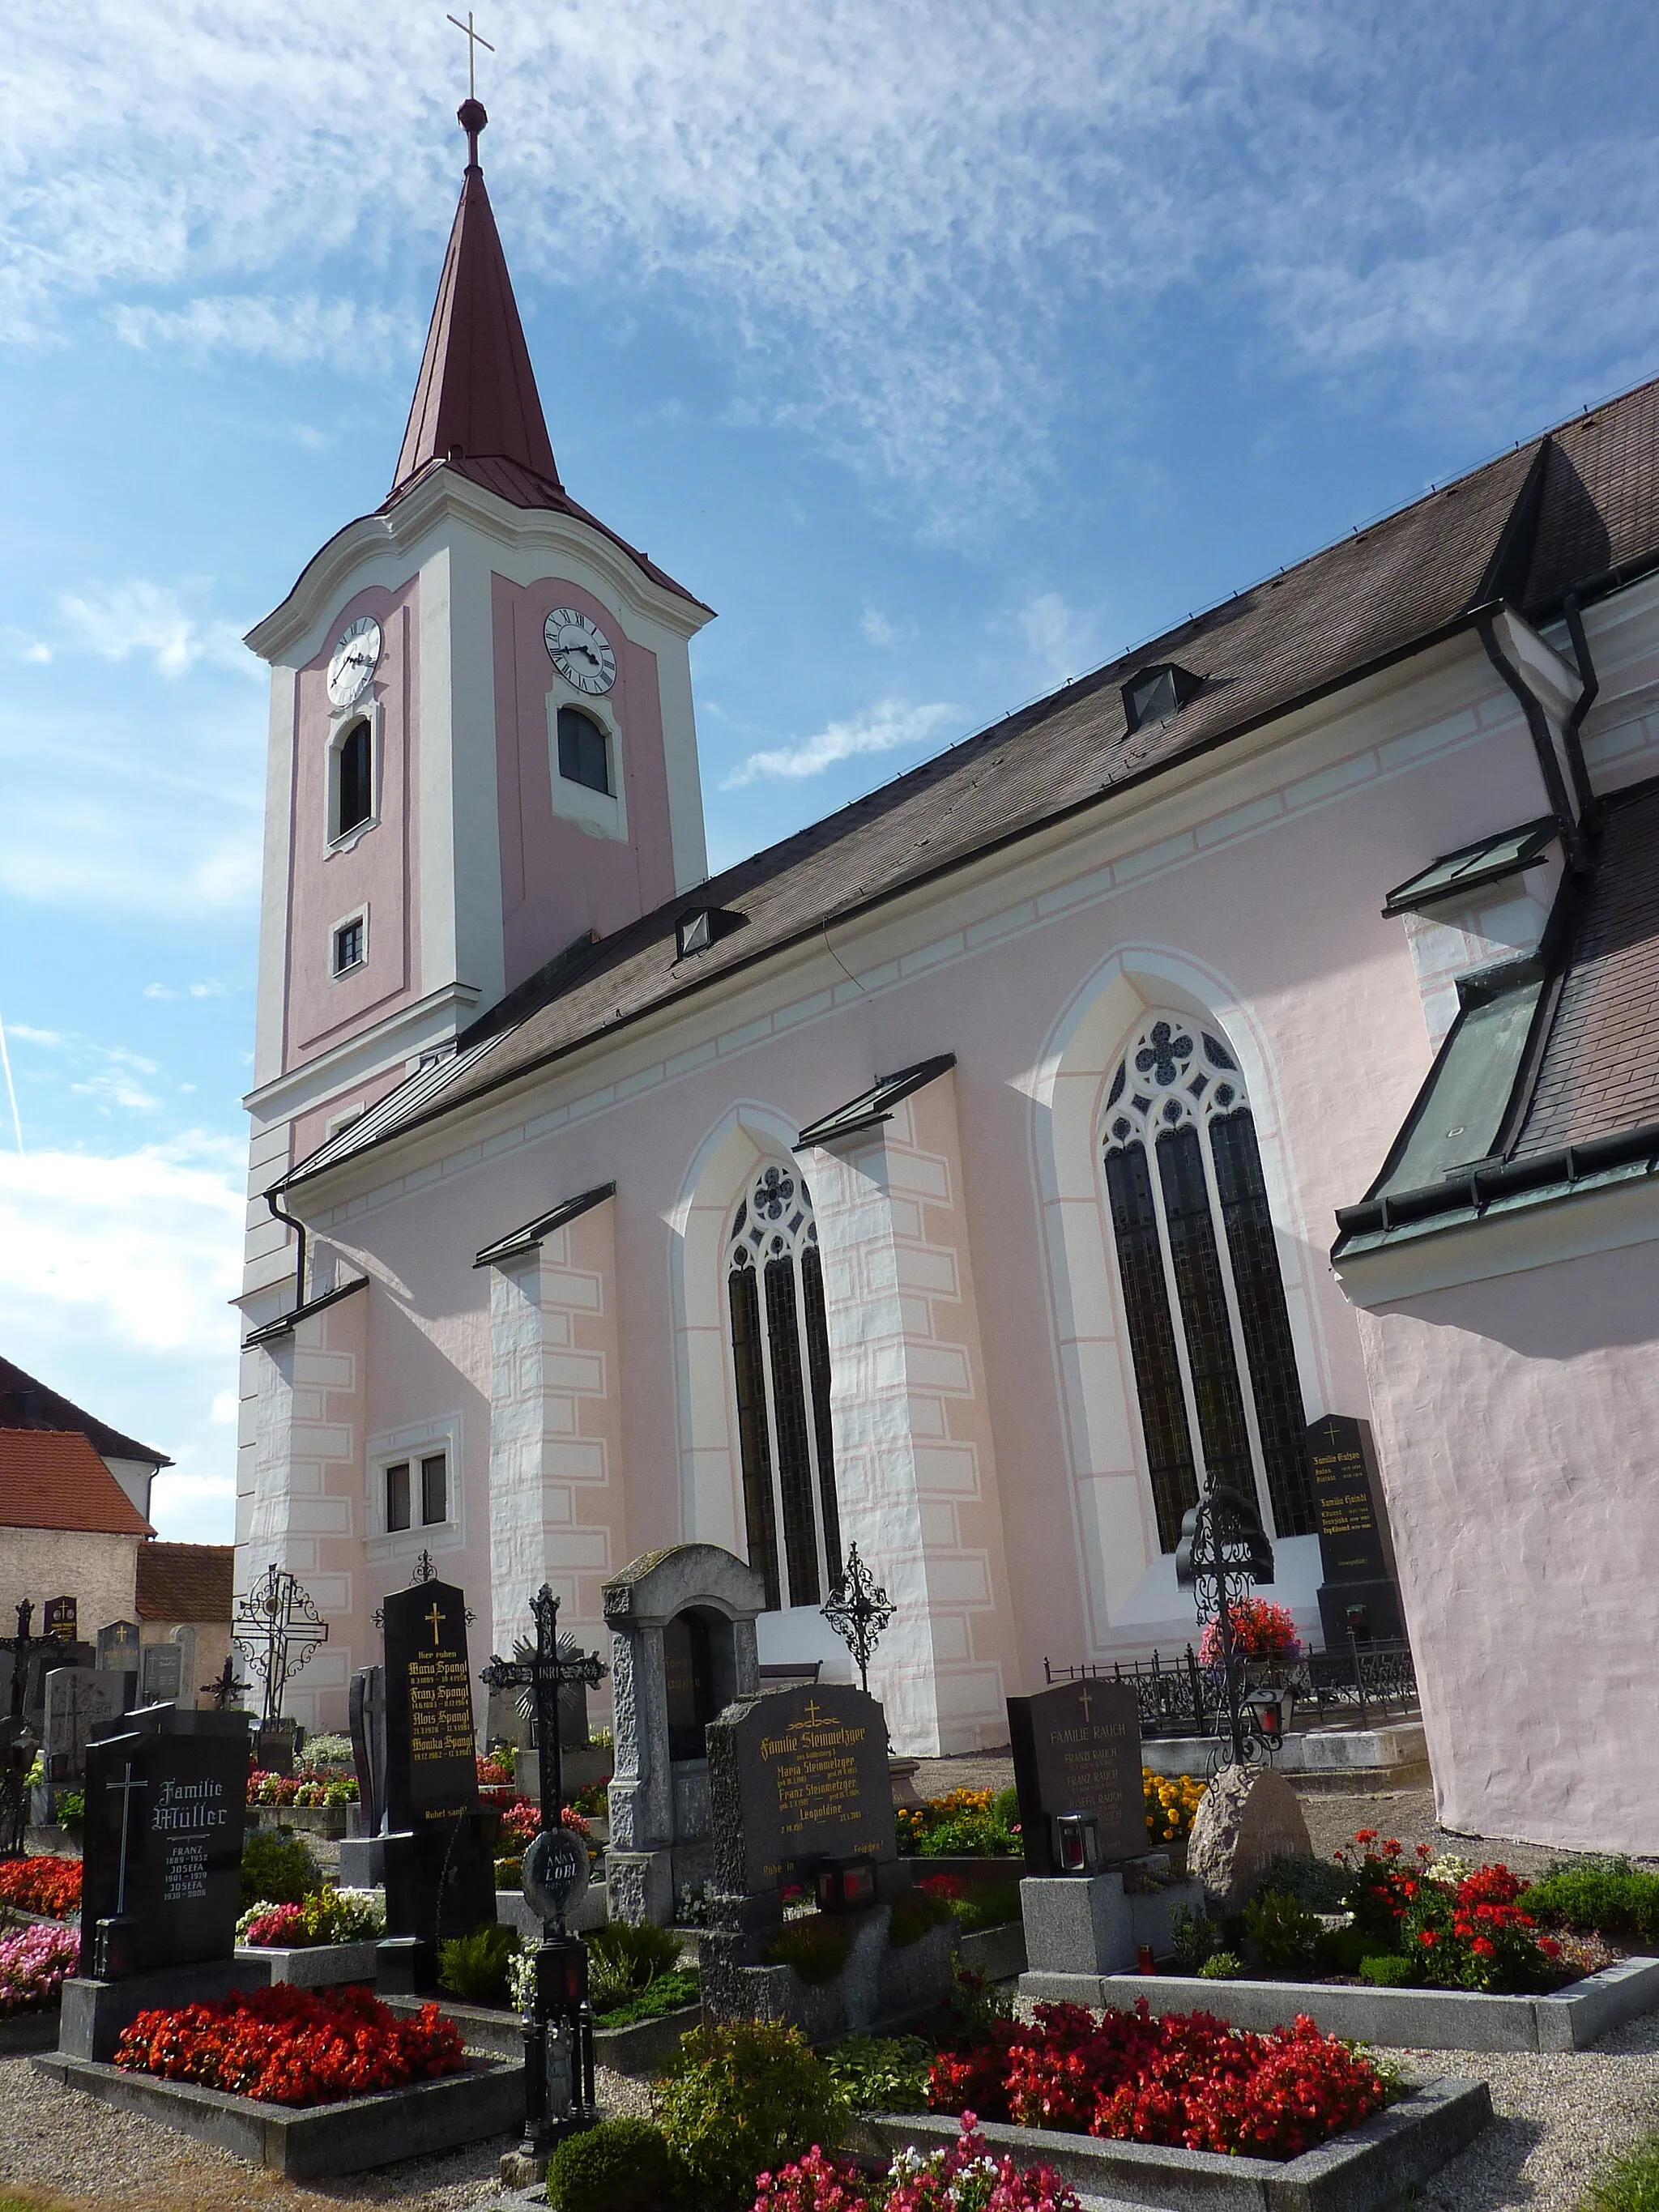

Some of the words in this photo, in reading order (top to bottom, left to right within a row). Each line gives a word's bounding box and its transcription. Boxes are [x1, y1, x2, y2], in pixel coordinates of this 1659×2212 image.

[407, 1661, 436, 1676] Maria
[435, 1660, 467, 1676] Spangl
[539, 1666, 559, 1680] INRI
[409, 1686, 437, 1703] Franz
[437, 1685, 470, 1702] Spangl
[412, 1711, 437, 1726] Alois
[437, 1709, 470, 1725] Spangl
[412, 1737, 443, 1751] Monika
[443, 1734, 473, 1750] Spangl
[1050, 1727, 1090, 1745] FAMILIE
[1093, 1723, 1126, 1740] RAUCH
[761, 1734, 798, 1762] Familie
[800, 1727, 866, 1748] Steinmetzger
[777, 1766, 801, 1779] Maria
[803, 1756, 855, 1774] Steinmetzger
[159, 1777, 223, 1806] Familie
[778, 1786, 804, 1801] Franz
[805, 1779, 857, 1796] Steinmetzger
[151, 1801, 228, 1831] Müller
[800, 1804, 842, 1822] Leopoldine
[173, 1845, 203, 1856] FRANZ
[170, 1863, 204, 1874] JOSEFA
[168, 1880, 203, 1892] JOSEFA
